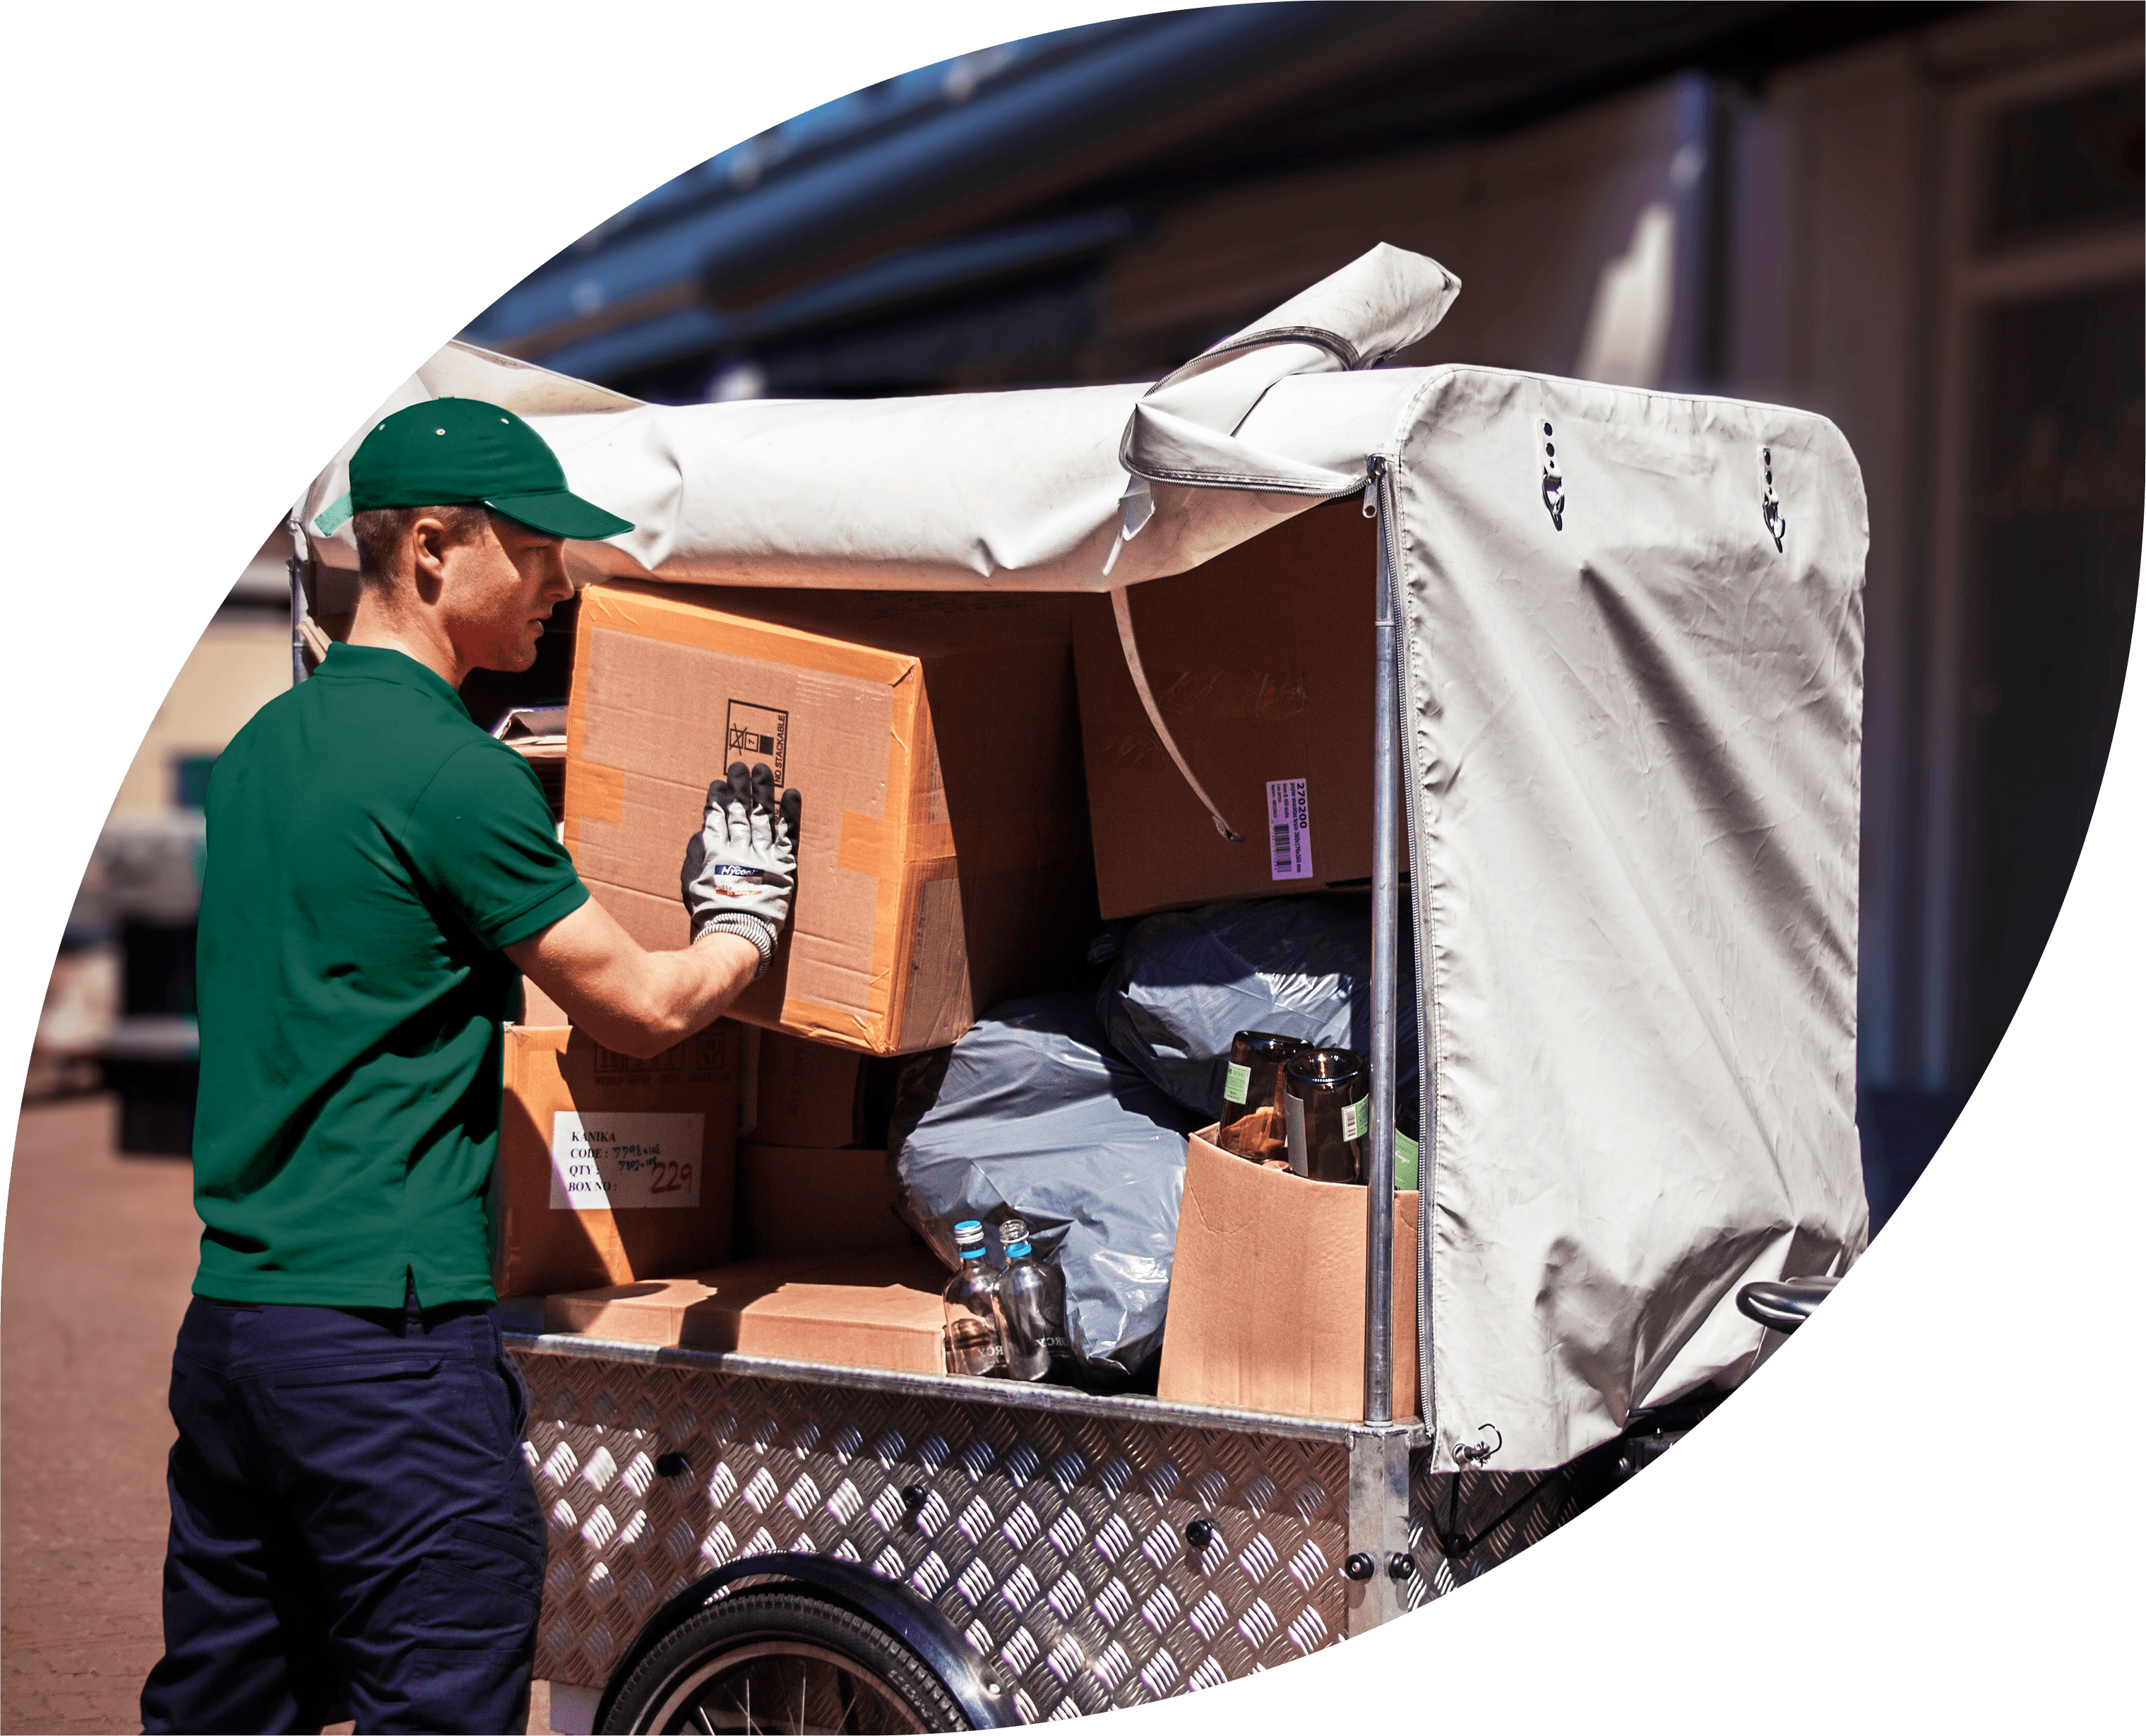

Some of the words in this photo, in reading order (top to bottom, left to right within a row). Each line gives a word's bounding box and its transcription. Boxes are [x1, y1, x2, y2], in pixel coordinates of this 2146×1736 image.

[775, 715, 785, 768] STACKABLE
[774, 770, 782, 783] NO
[1297, 783, 1307, 828] 270200
[572, 1131, 616, 1142] KANIKA
[568, 1182, 592, 1191] BOX
[650, 1160, 693, 1194] 229
